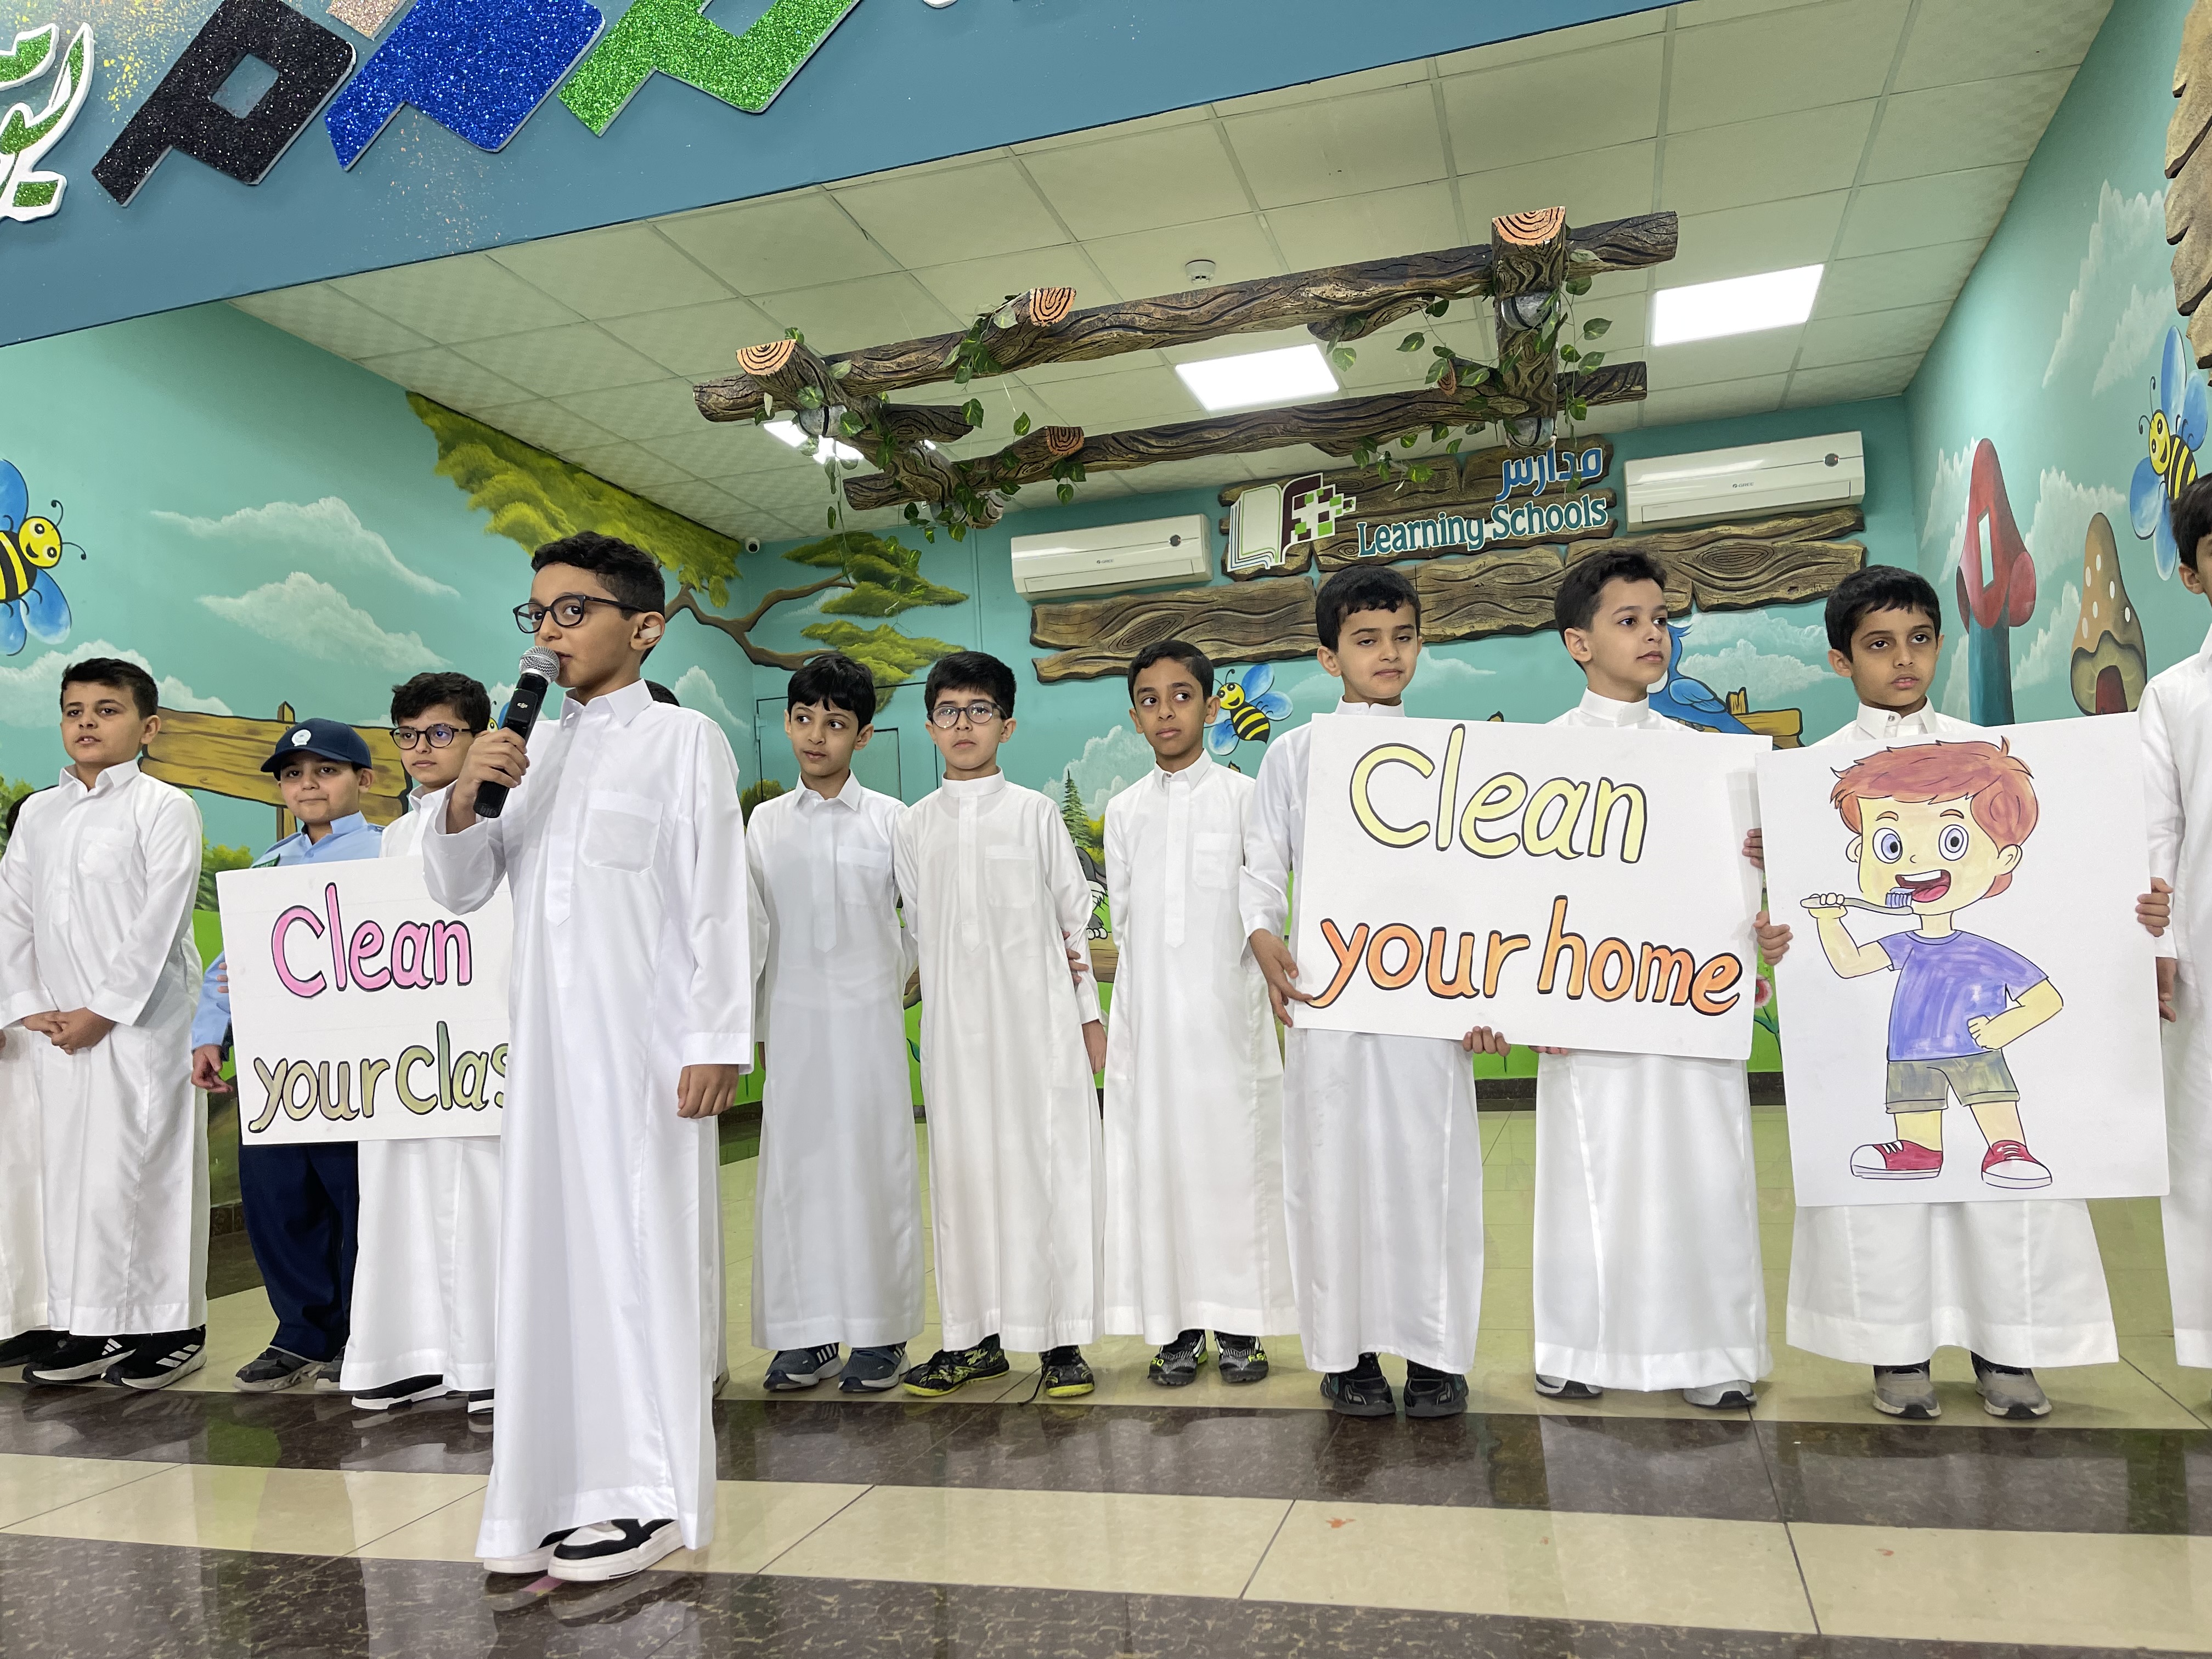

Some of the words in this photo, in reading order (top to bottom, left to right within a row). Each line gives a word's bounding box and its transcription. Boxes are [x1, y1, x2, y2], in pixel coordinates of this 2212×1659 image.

[1495, 445, 1603, 503] مدارس
[1357, 511, 1486, 557] Learning
[1491, 493, 1607, 540] Schools
[1350, 724, 1647, 864] Clean
[272, 882, 472, 998] Clean
[1308, 918, 1530, 1009] your
[1538, 895, 1743, 1016] home
[249, 1058, 391, 1133] your
